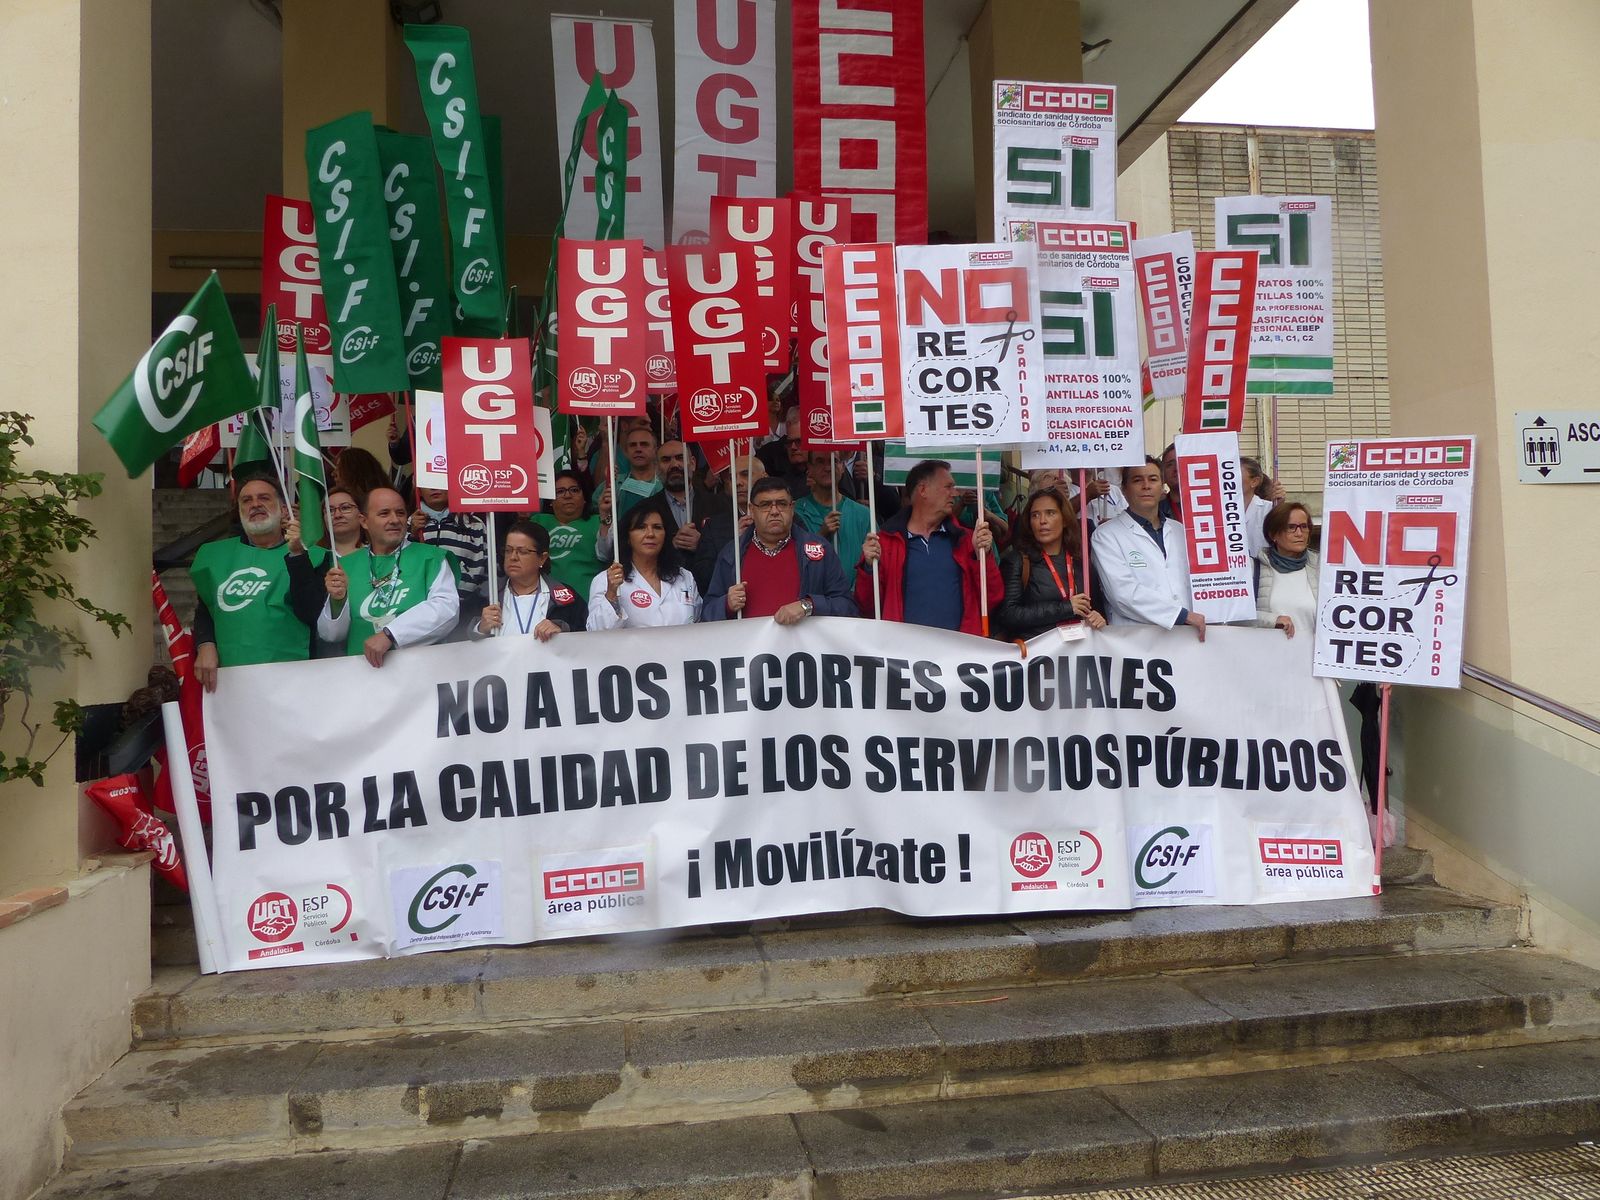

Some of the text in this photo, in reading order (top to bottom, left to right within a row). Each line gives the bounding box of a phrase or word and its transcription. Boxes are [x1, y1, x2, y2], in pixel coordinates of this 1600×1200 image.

[1029, 91, 1092, 109] CCOO
[997, 118, 1055, 127] sociosanitarios
[1069, 120, 1101, 129] Córdoba
[1044, 113, 1073, 121] sanidad
[1043, 229, 1108, 246] CCOO
[279, 205, 323, 320] UGT
[1087, 260, 1120, 268] Córdoba
[1093, 254, 1097, 262] y
[904, 266, 1031, 326] NO
[1144, 260, 1176, 349] CCOO
[1256, 292, 1323, 300] TILLAS 100%
[575, 248, 628, 365] UGT
[685, 252, 746, 385] UGT
[842, 251, 885, 397] CCOO
[1202, 258, 1243, 396] CCOO
[917, 330, 967, 358] RE
[1258, 335, 1272, 343] A2,
[1286, 335, 1300, 343] C1,
[155, 331, 214, 401] CSIF
[649, 360, 668, 370] UGT
[573, 373, 597, 384] UGT
[604, 374, 621, 383] FSP
[918, 366, 1001, 394] COR
[1045, 374, 1131, 383] NTRATOS 100%
[1016, 344, 1031, 433] SANIDAD
[1046, 390, 1132, 399] ANTILLAS 100%
[461, 347, 517, 461] UGT
[694, 394, 718, 407] UGT
[724, 393, 743, 404] FSP
[920, 403, 994, 431] TES
[1047, 418, 1133, 429] CLASIFICACIÓN
[1048, 431, 1130, 439] OFESIONAL EBEP
[1065, 444, 1079, 453] A2,
[1082, 444, 1090, 452] B,
[1094, 444, 1108, 452] C1,
[1111, 443, 1123, 451] C2
[1366, 447, 1443, 465] CCOO
[463, 470, 488, 481] UGT
[495, 470, 513, 479] FSP
[1328, 477, 1454, 487] sociosanitarios de Córdoba
[1329, 471, 1367, 479] sindicato
[1420, 472, 1426, 480] y
[1428, 470, 1469, 478] sectores
[1187, 462, 1219, 566] CCOO
[1222, 461, 1244, 552] CONTRATOS
[549, 535, 583, 548] CSIF
[1326, 510, 1457, 567] NO
[225, 579, 272, 597] CSIF
[1334, 570, 1384, 596] RE
[1331, 605, 1414, 633] COR
[1431, 589, 1444, 677] SANIDAD
[1329, 638, 1403, 668] TES
[437, 651, 1177, 739] NO A LOS RECORTES SOCIALES
[236, 781, 351, 851] POR
[361, 770, 428, 834] LA
[438, 746, 672, 822] CALIDAD
[685, 739, 749, 800] DE
[761, 733, 852, 794] LOS
[864, 732, 1123, 793] SERVICIOS
[1125, 726, 1347, 793] PÚBLICOS
[1015, 839, 1047, 857] UGT
[1264, 843, 1324, 860] CCOO
[714, 827, 946, 890] Movilízate
[957, 833, 972, 883] !
[550, 870, 621, 893] CCOO
[1265, 865, 1344, 880] área pública
[254, 899, 291, 923] UGT
[548, 894, 644, 914] área pública
[304, 920, 327, 928] Públicos
[314, 938, 340, 947] Córdoba
